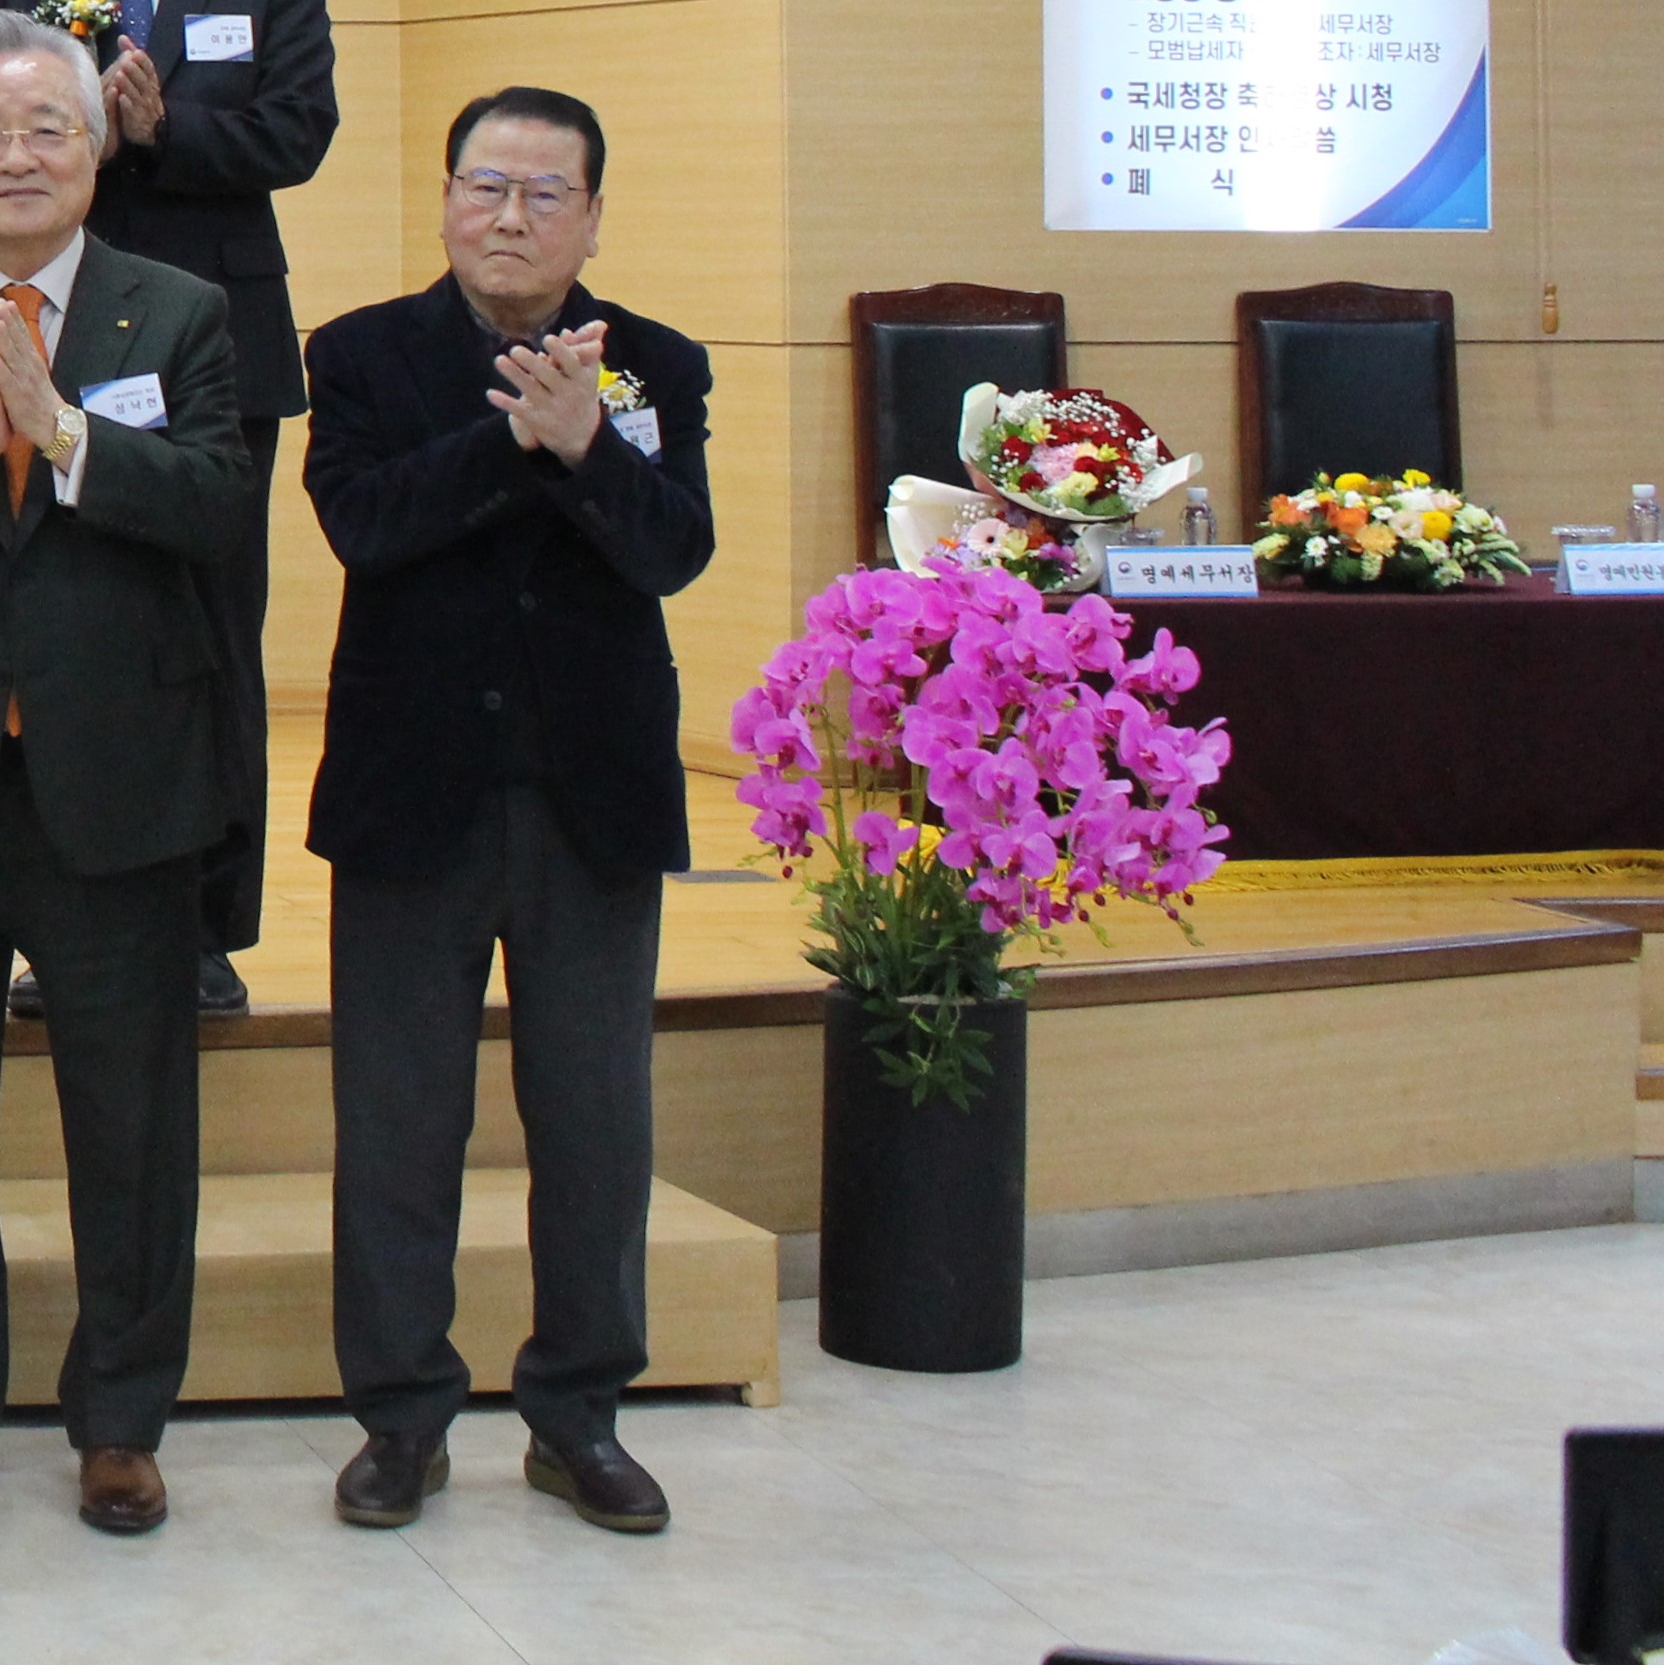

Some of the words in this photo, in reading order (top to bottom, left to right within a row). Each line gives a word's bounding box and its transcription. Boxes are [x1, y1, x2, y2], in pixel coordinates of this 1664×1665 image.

[1148, 12, 1223, 33] 장기근속
[1127, 82, 1228, 110] 국세청장
[1347, 83, 1393, 111] 시청
[1128, 125, 1228, 153] 세무서장
[1141, 564, 1254, 585] 명예세무서장
